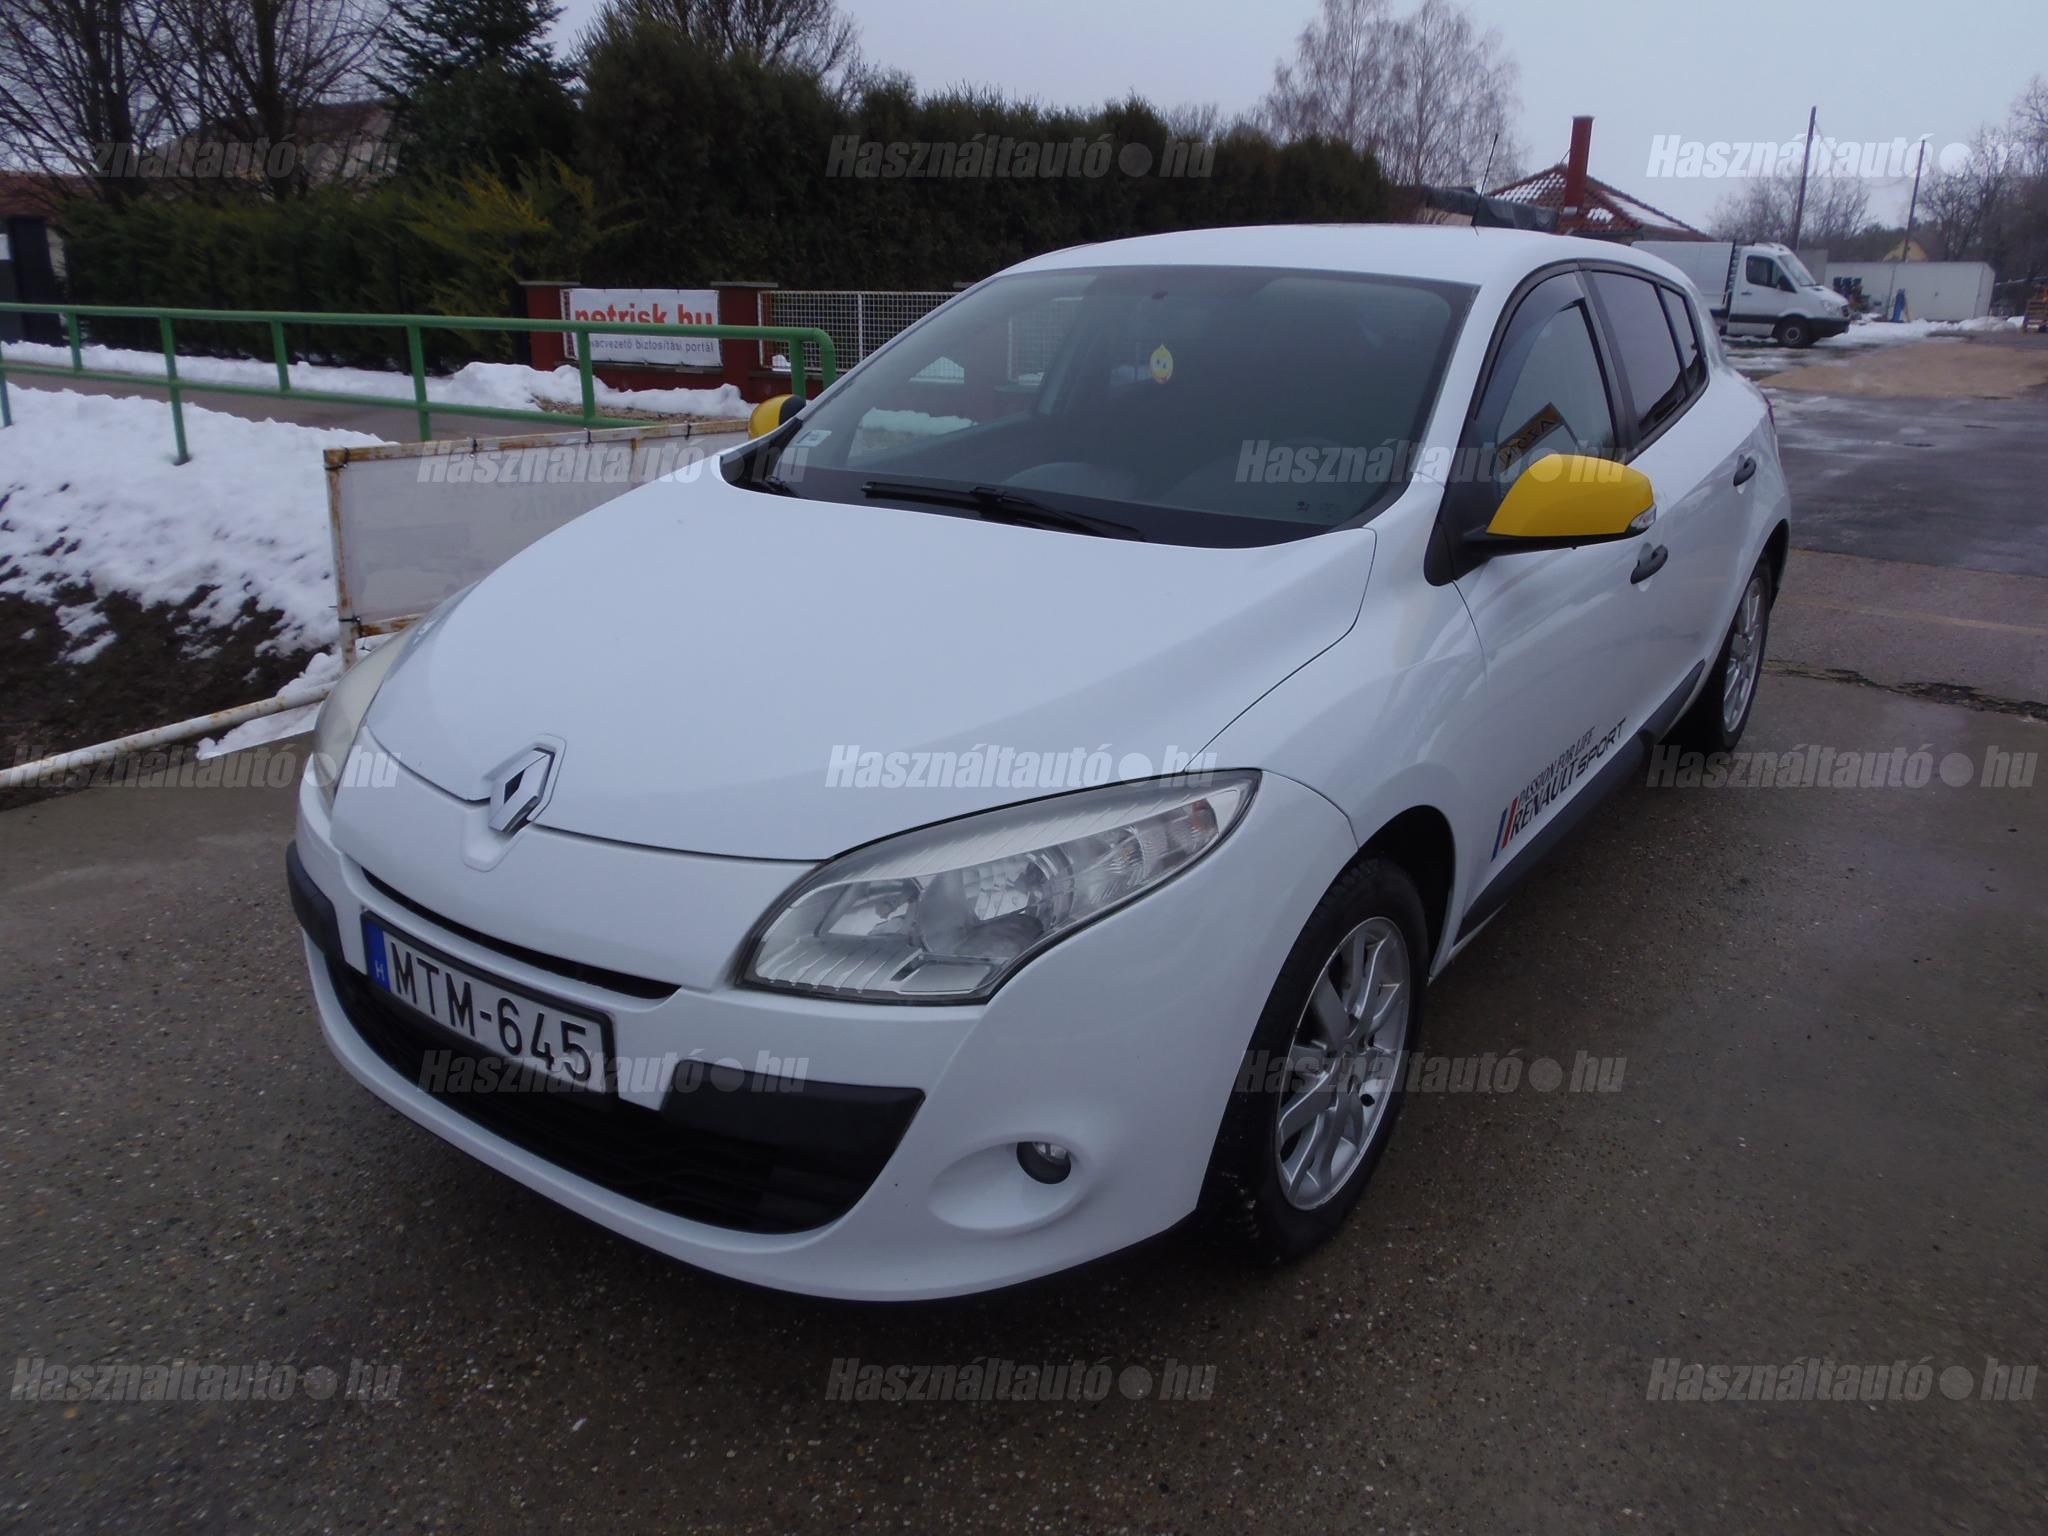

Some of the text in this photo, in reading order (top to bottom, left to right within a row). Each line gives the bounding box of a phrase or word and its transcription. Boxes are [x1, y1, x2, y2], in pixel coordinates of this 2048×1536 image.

[685, 341, 714, 353] portál
[1510, 717, 1626, 841] RENAULT SPORT
[391, 942, 593, 1083] MTM-645
